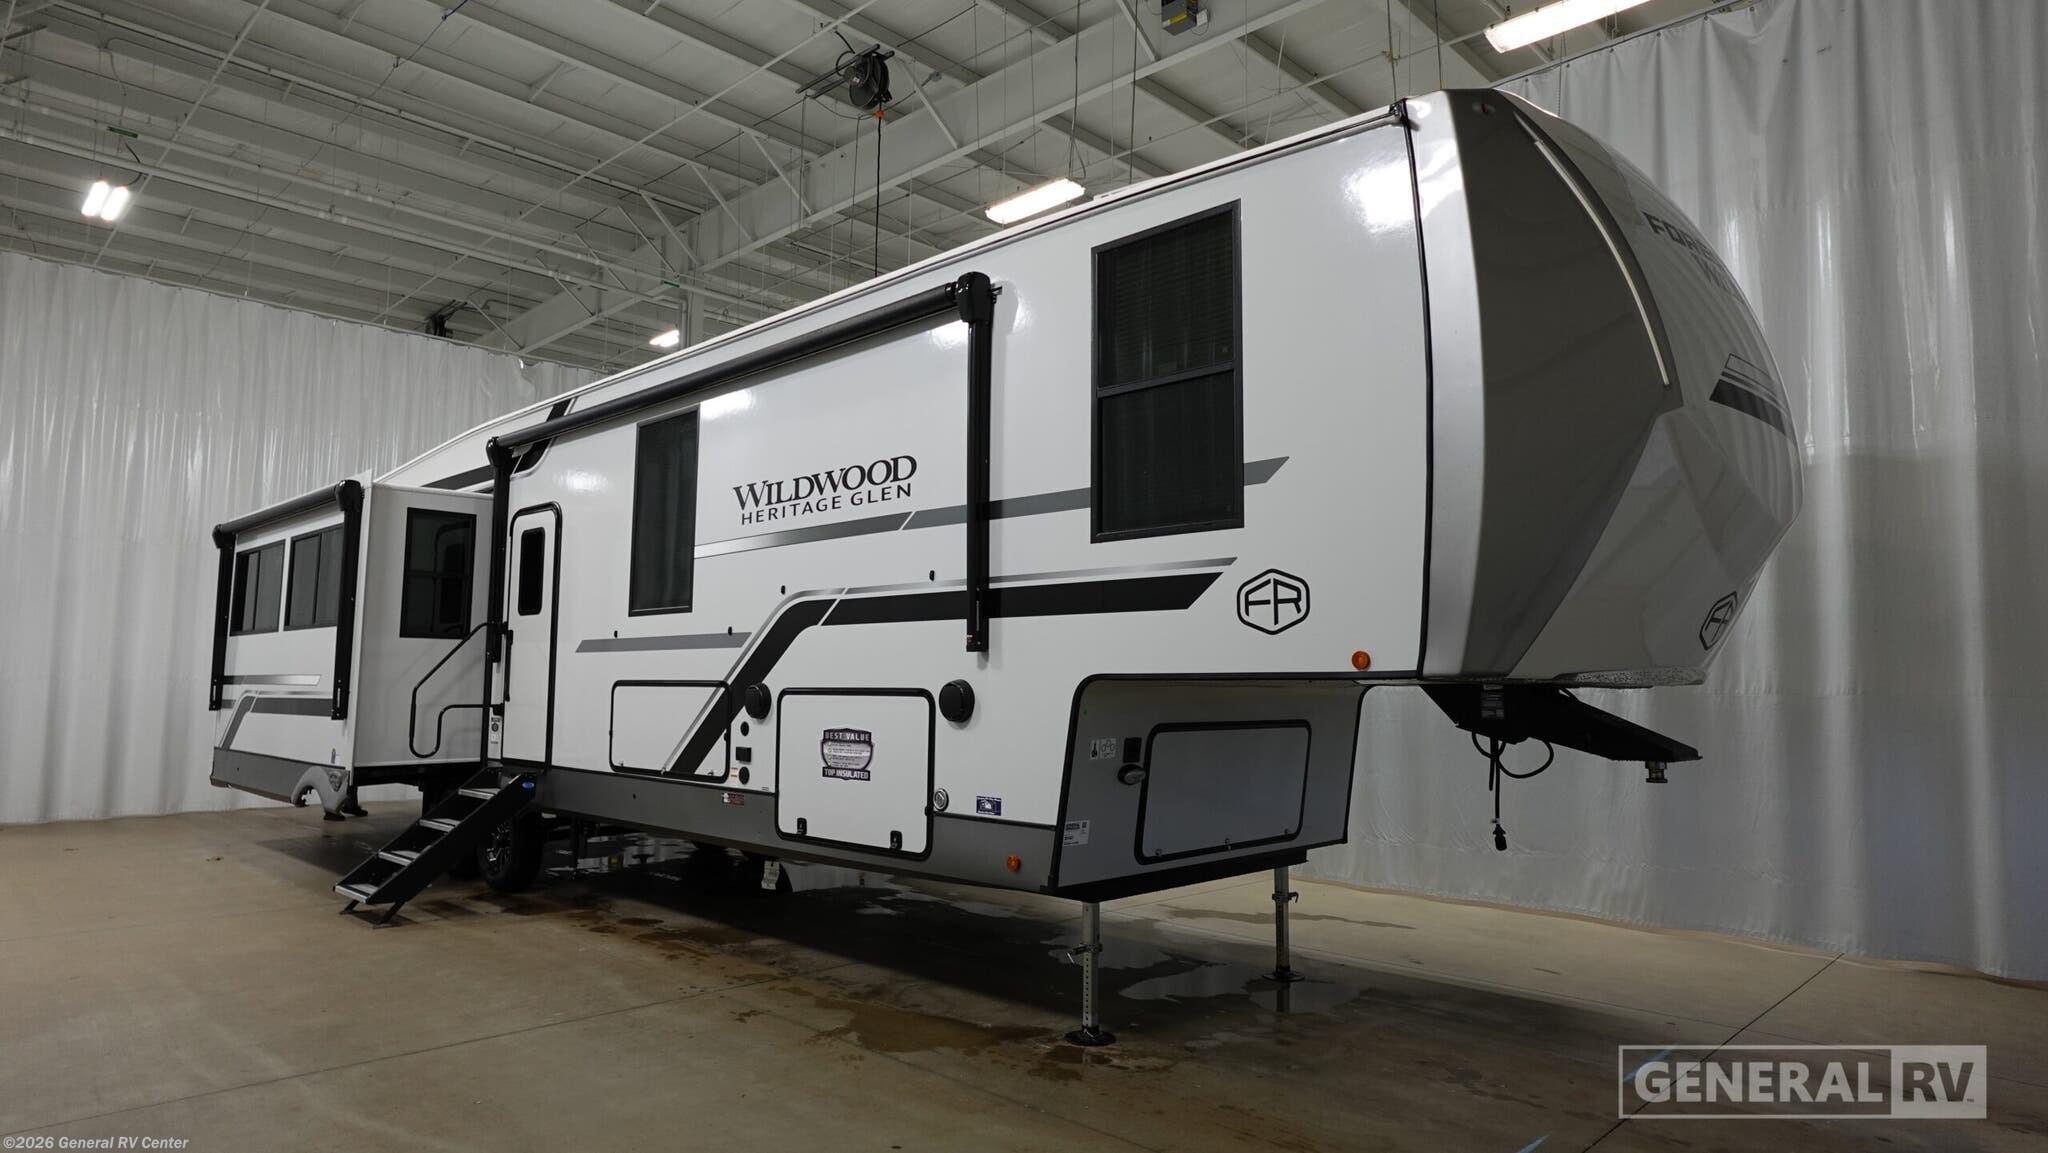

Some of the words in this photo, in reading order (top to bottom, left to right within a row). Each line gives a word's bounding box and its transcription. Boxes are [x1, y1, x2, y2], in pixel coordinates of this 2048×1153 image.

[1641, 209, 1717, 263] FORE
[733, 455, 917, 510] WILDWOOD
[742, 495, 842, 525] HERITAGE
[850, 483, 912, 506] GLEN
[825, 731, 843, 739] BEST
[846, 732, 870, 741] VALUE
[824, 768, 836, 776] TOP
[836, 769, 869, 779] INSULATED
